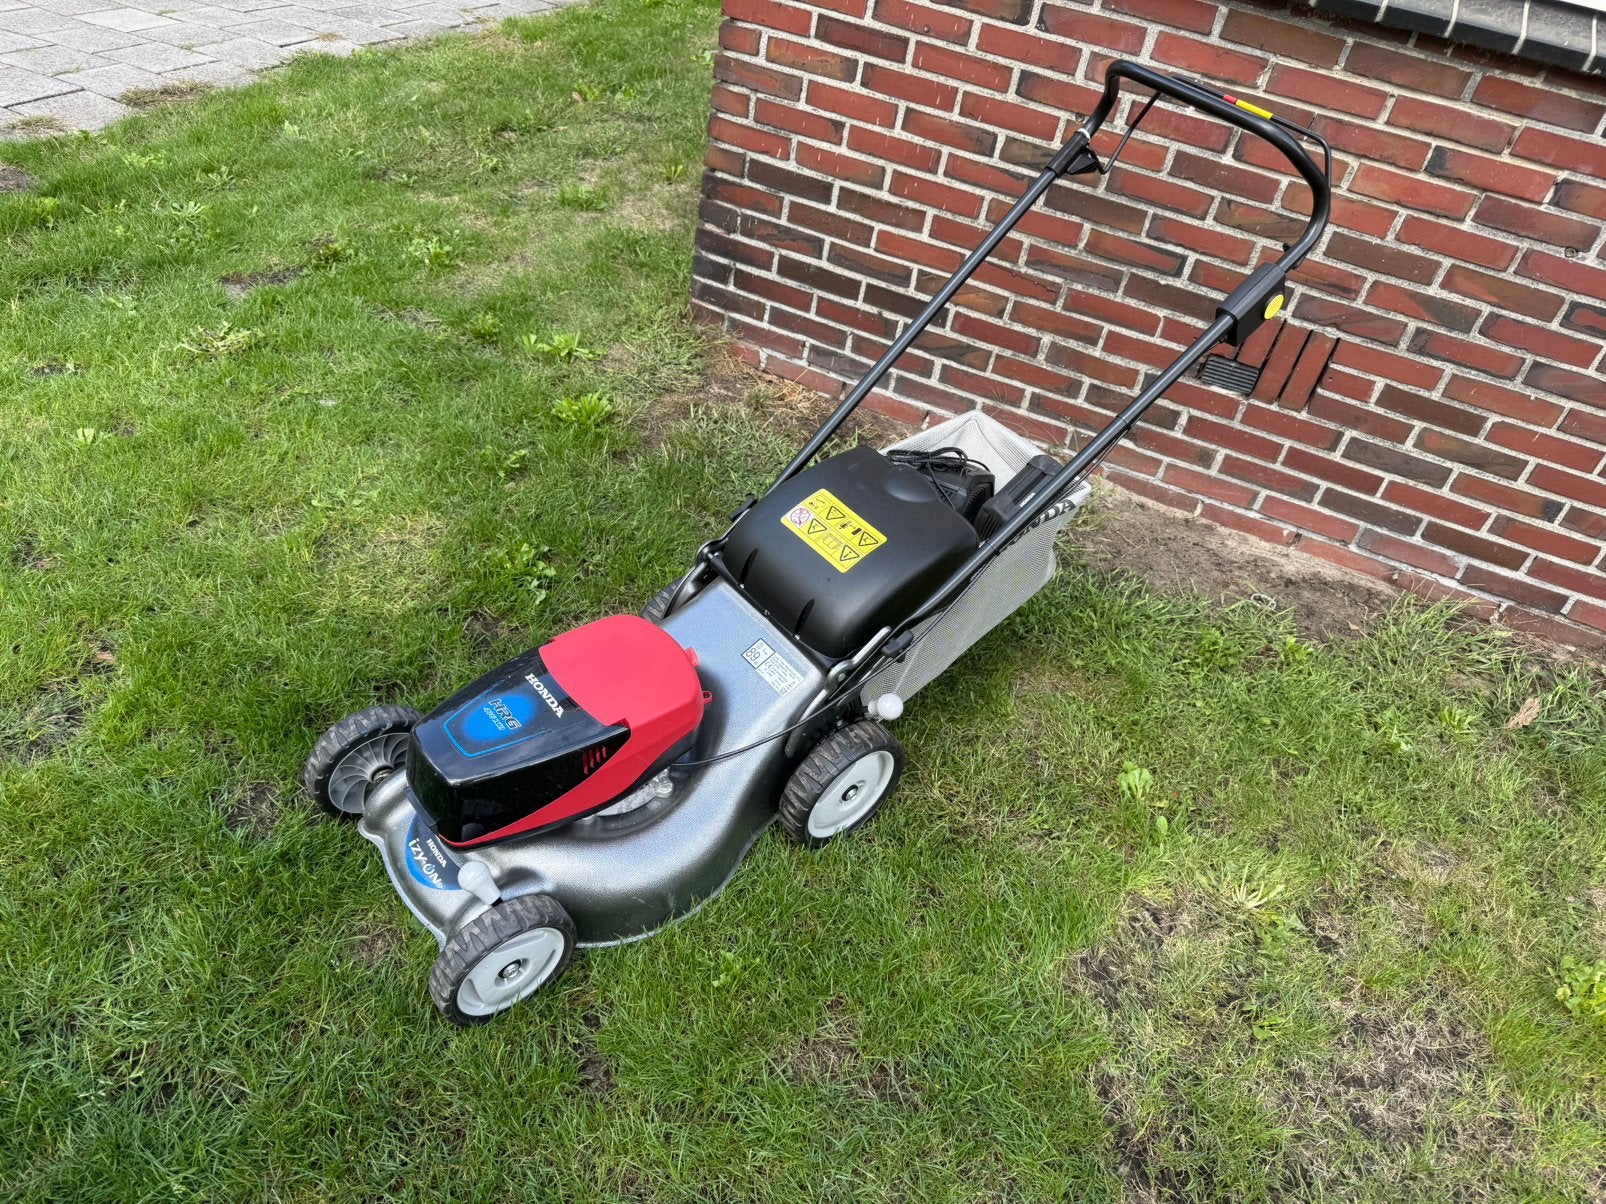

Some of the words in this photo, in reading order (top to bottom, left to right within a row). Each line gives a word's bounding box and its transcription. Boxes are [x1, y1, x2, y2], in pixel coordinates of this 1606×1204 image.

[745, 647, 761, 662] 89
[524, 672, 565, 718] HONDA
[487, 698, 522, 730] HRG
[426, 838, 447, 868] HONDA
